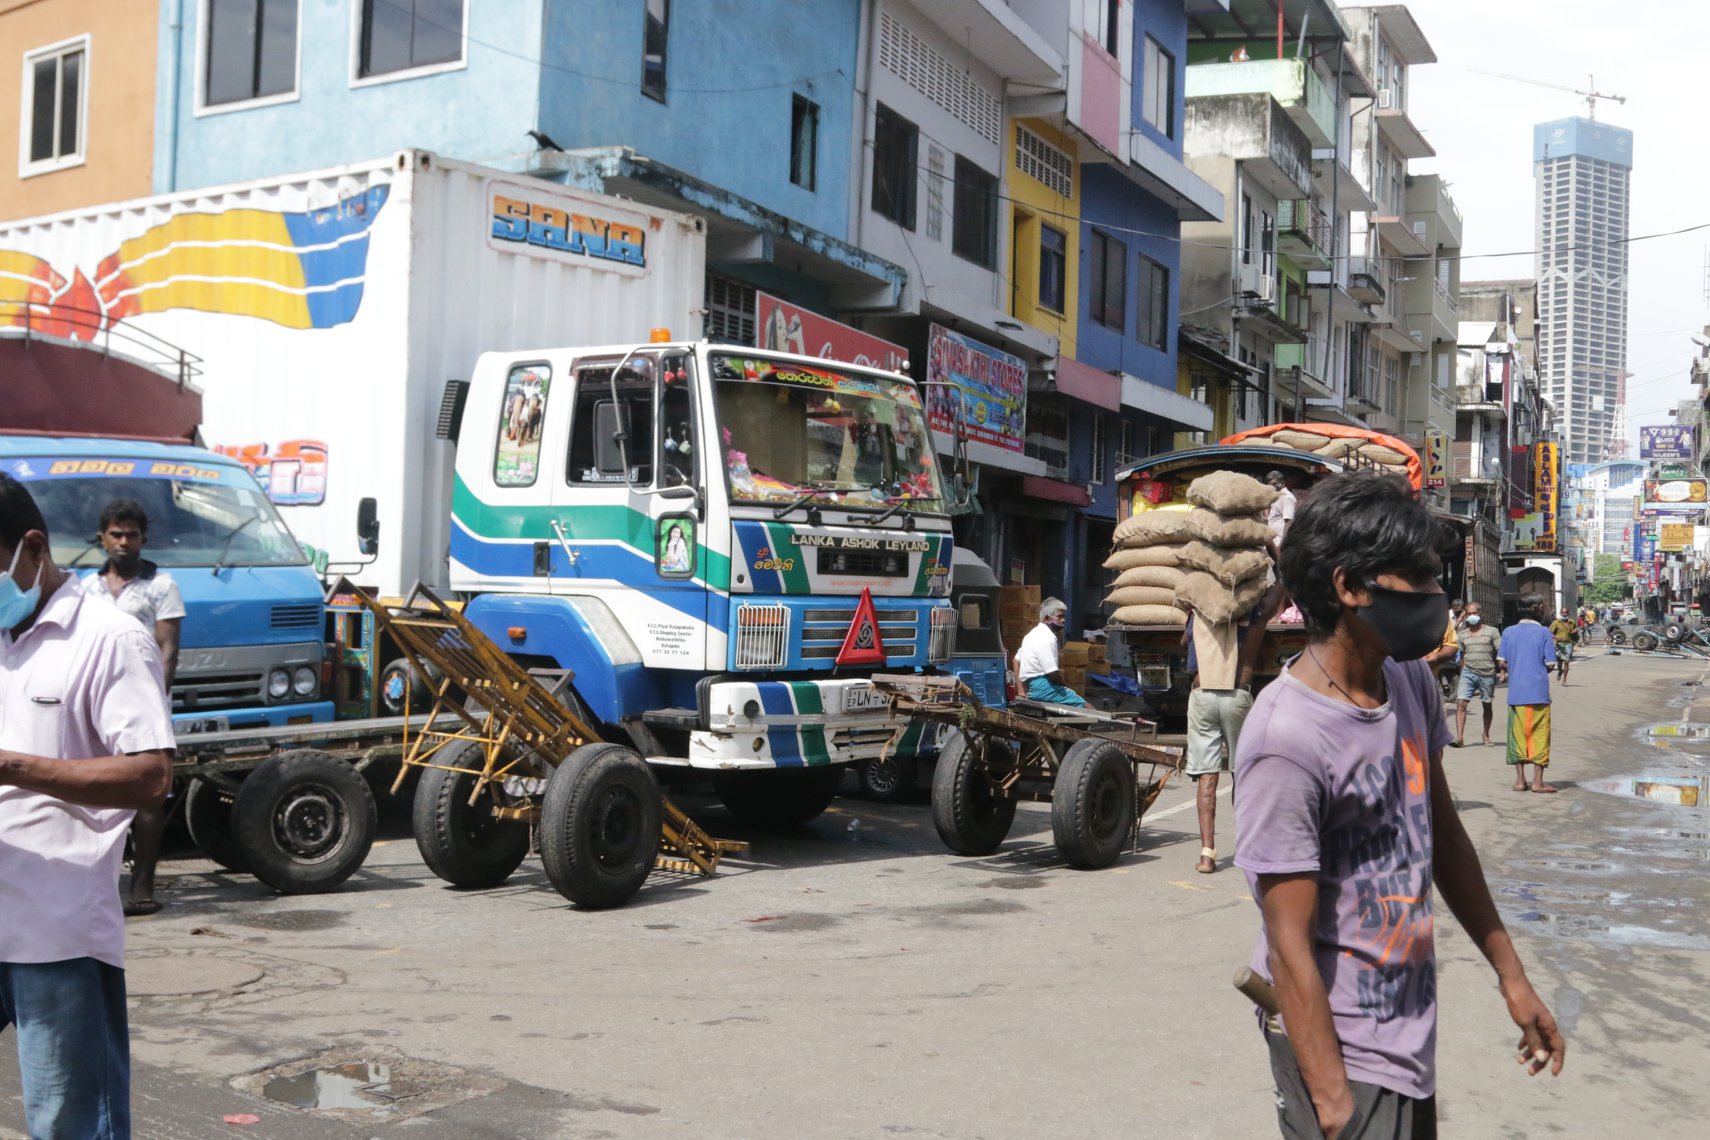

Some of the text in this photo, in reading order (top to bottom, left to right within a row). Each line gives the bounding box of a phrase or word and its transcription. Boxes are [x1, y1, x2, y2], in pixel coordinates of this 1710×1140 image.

[491, 194, 646, 268] SANA
[991, 356, 1025, 395] STORES
[791, 534, 930, 552] LANKA ASHOK LEYLAND
[1536, 541, 1554, 549] 188
